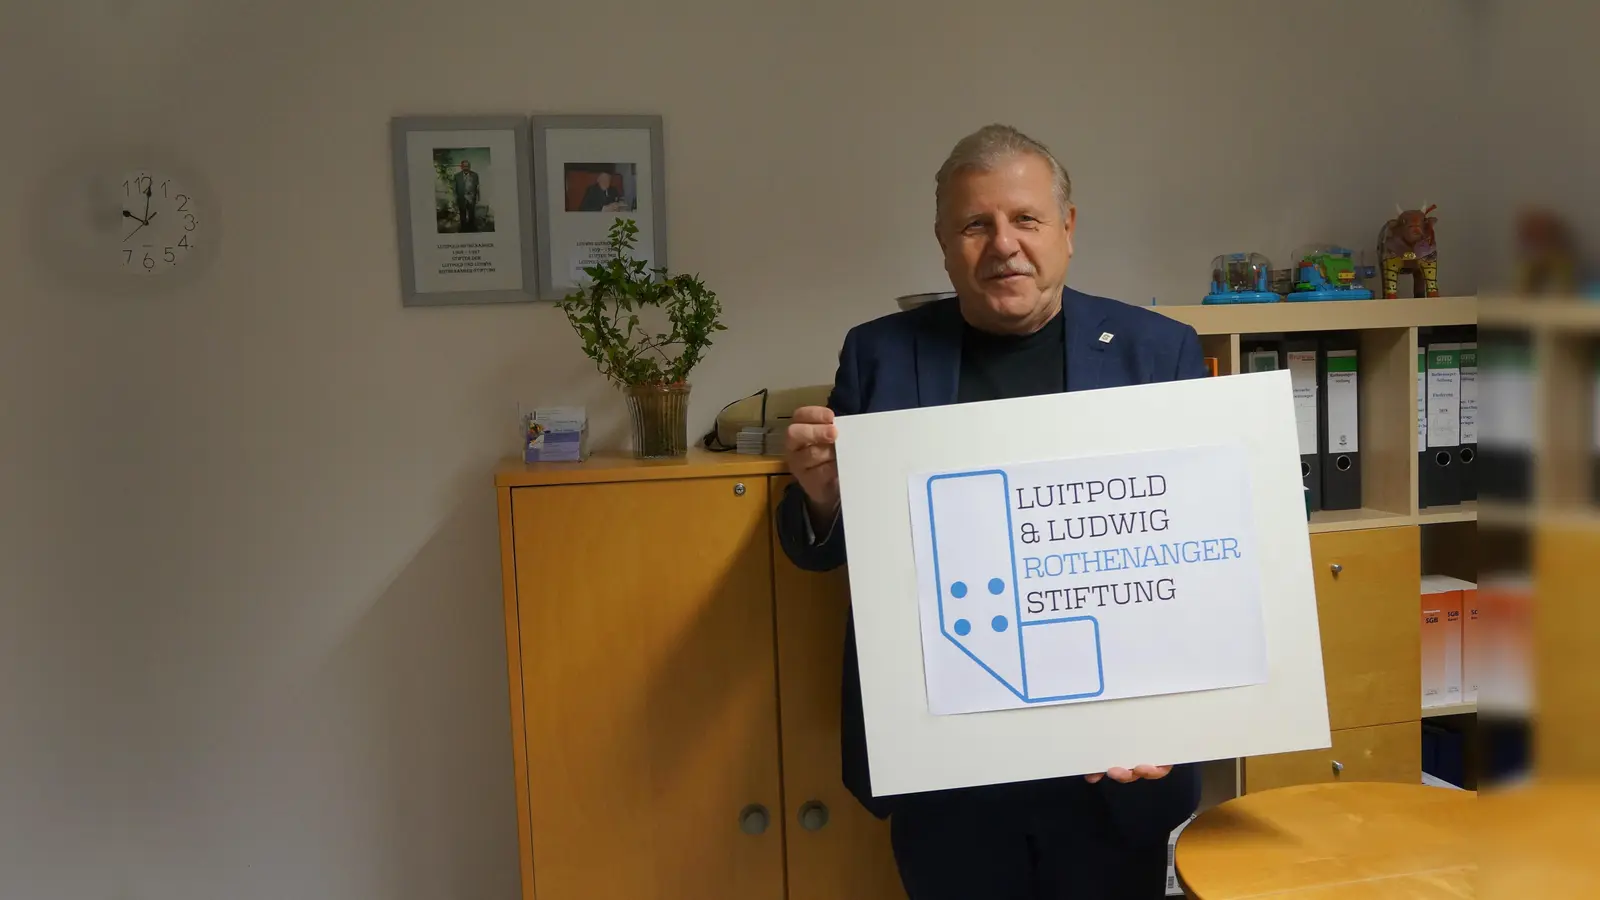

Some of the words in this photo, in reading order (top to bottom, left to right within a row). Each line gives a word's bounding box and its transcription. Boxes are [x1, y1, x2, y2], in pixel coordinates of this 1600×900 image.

[160, 181, 168, 198] 1
[175, 194, 188, 212] 2
[184, 214, 196, 232] 3
[177, 235, 189, 250] 4
[122, 249, 132, 264] 7
[142, 252, 155, 269] 6
[163, 246, 175, 263] 5
[1016, 474, 1167, 509] LUITPOLD
[1020, 522, 1040, 544] &
[1047, 509, 1170, 542] LUDWIG
[1023, 537, 1241, 578] ROTHENANGER
[1026, 578, 1177, 614] STIFTUNG
